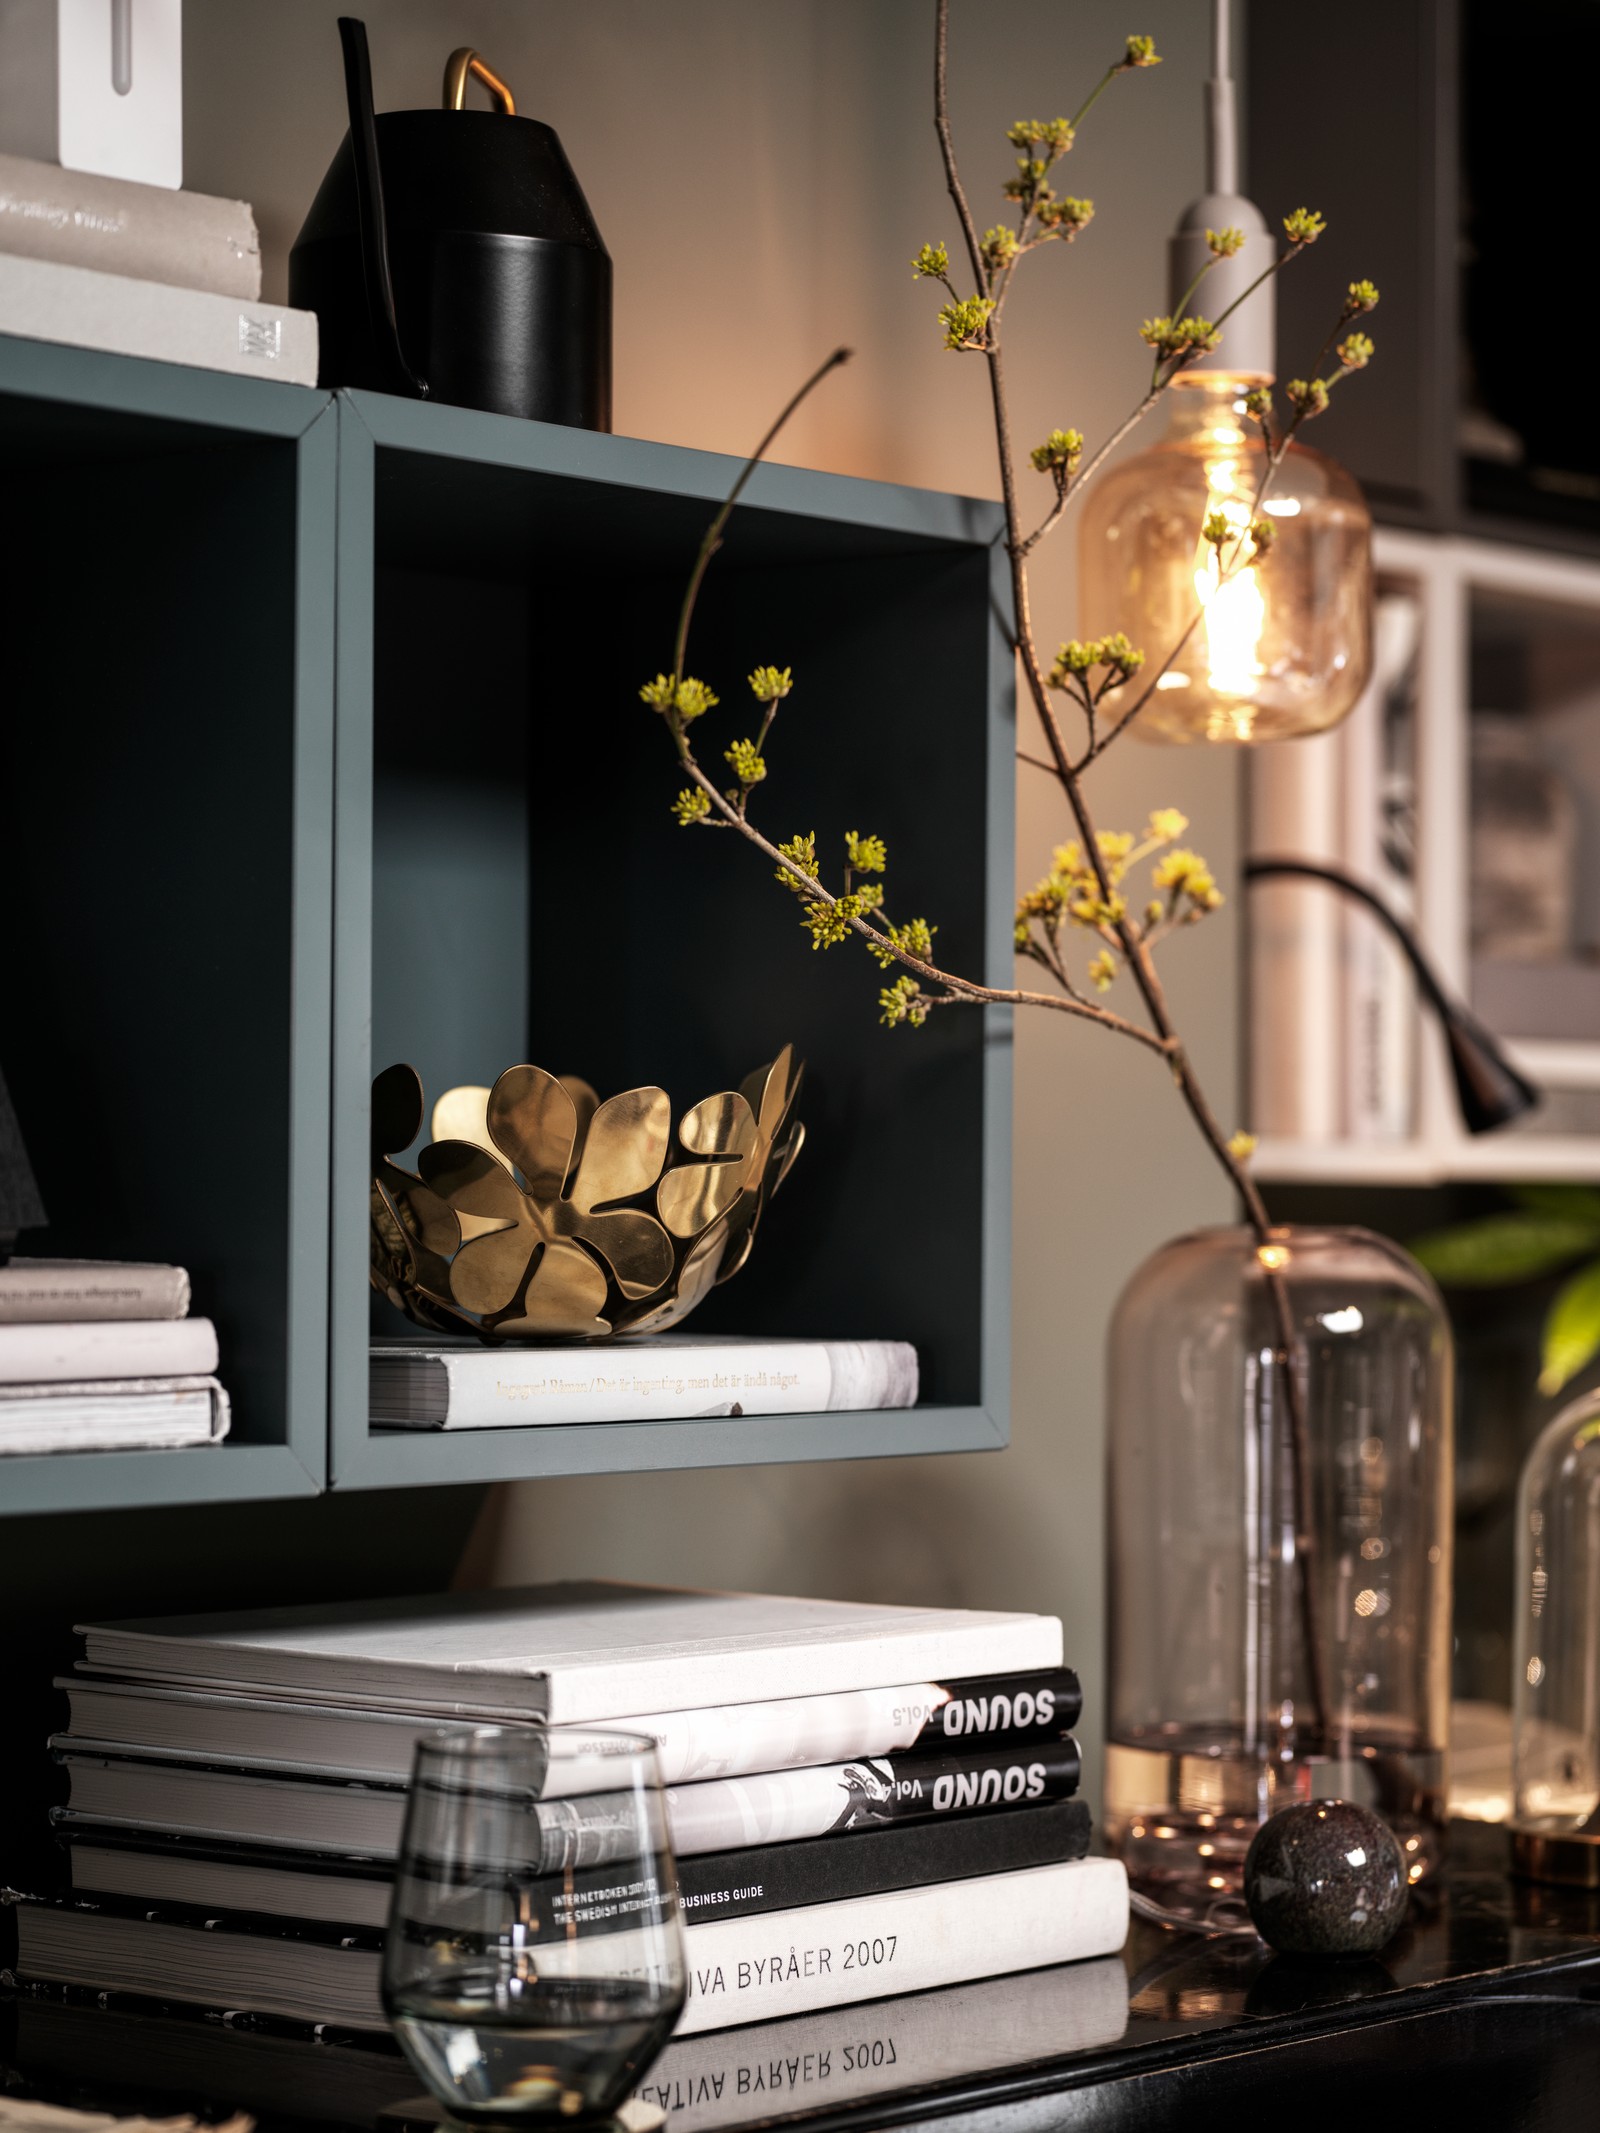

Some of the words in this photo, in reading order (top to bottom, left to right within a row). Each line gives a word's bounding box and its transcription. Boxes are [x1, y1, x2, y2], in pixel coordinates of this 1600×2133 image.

[619, 1377, 631, 1392] är
[688, 1378, 710, 1389] men
[712, 1373, 729, 1388] det
[731, 1374, 742, 1388] är
[744, 1371, 768, 1387] ändå
[770, 1371, 801, 1391] något.
[892, 1703, 935, 1727] Vol.5
[944, 1689, 1056, 1737] SOUND
[881, 1778, 924, 1803] Vol.4
[932, 1763, 1048, 1811] SOUND
[553, 1910, 573, 1926] THE
[574, 1903, 618, 1923] SWEDISH
[679, 1890, 731, 1909] BUSINESS
[732, 1884, 764, 1901] GUIDE
[737, 1946, 832, 1990] BYRÅER
[842, 1935, 898, 1970] 2007
